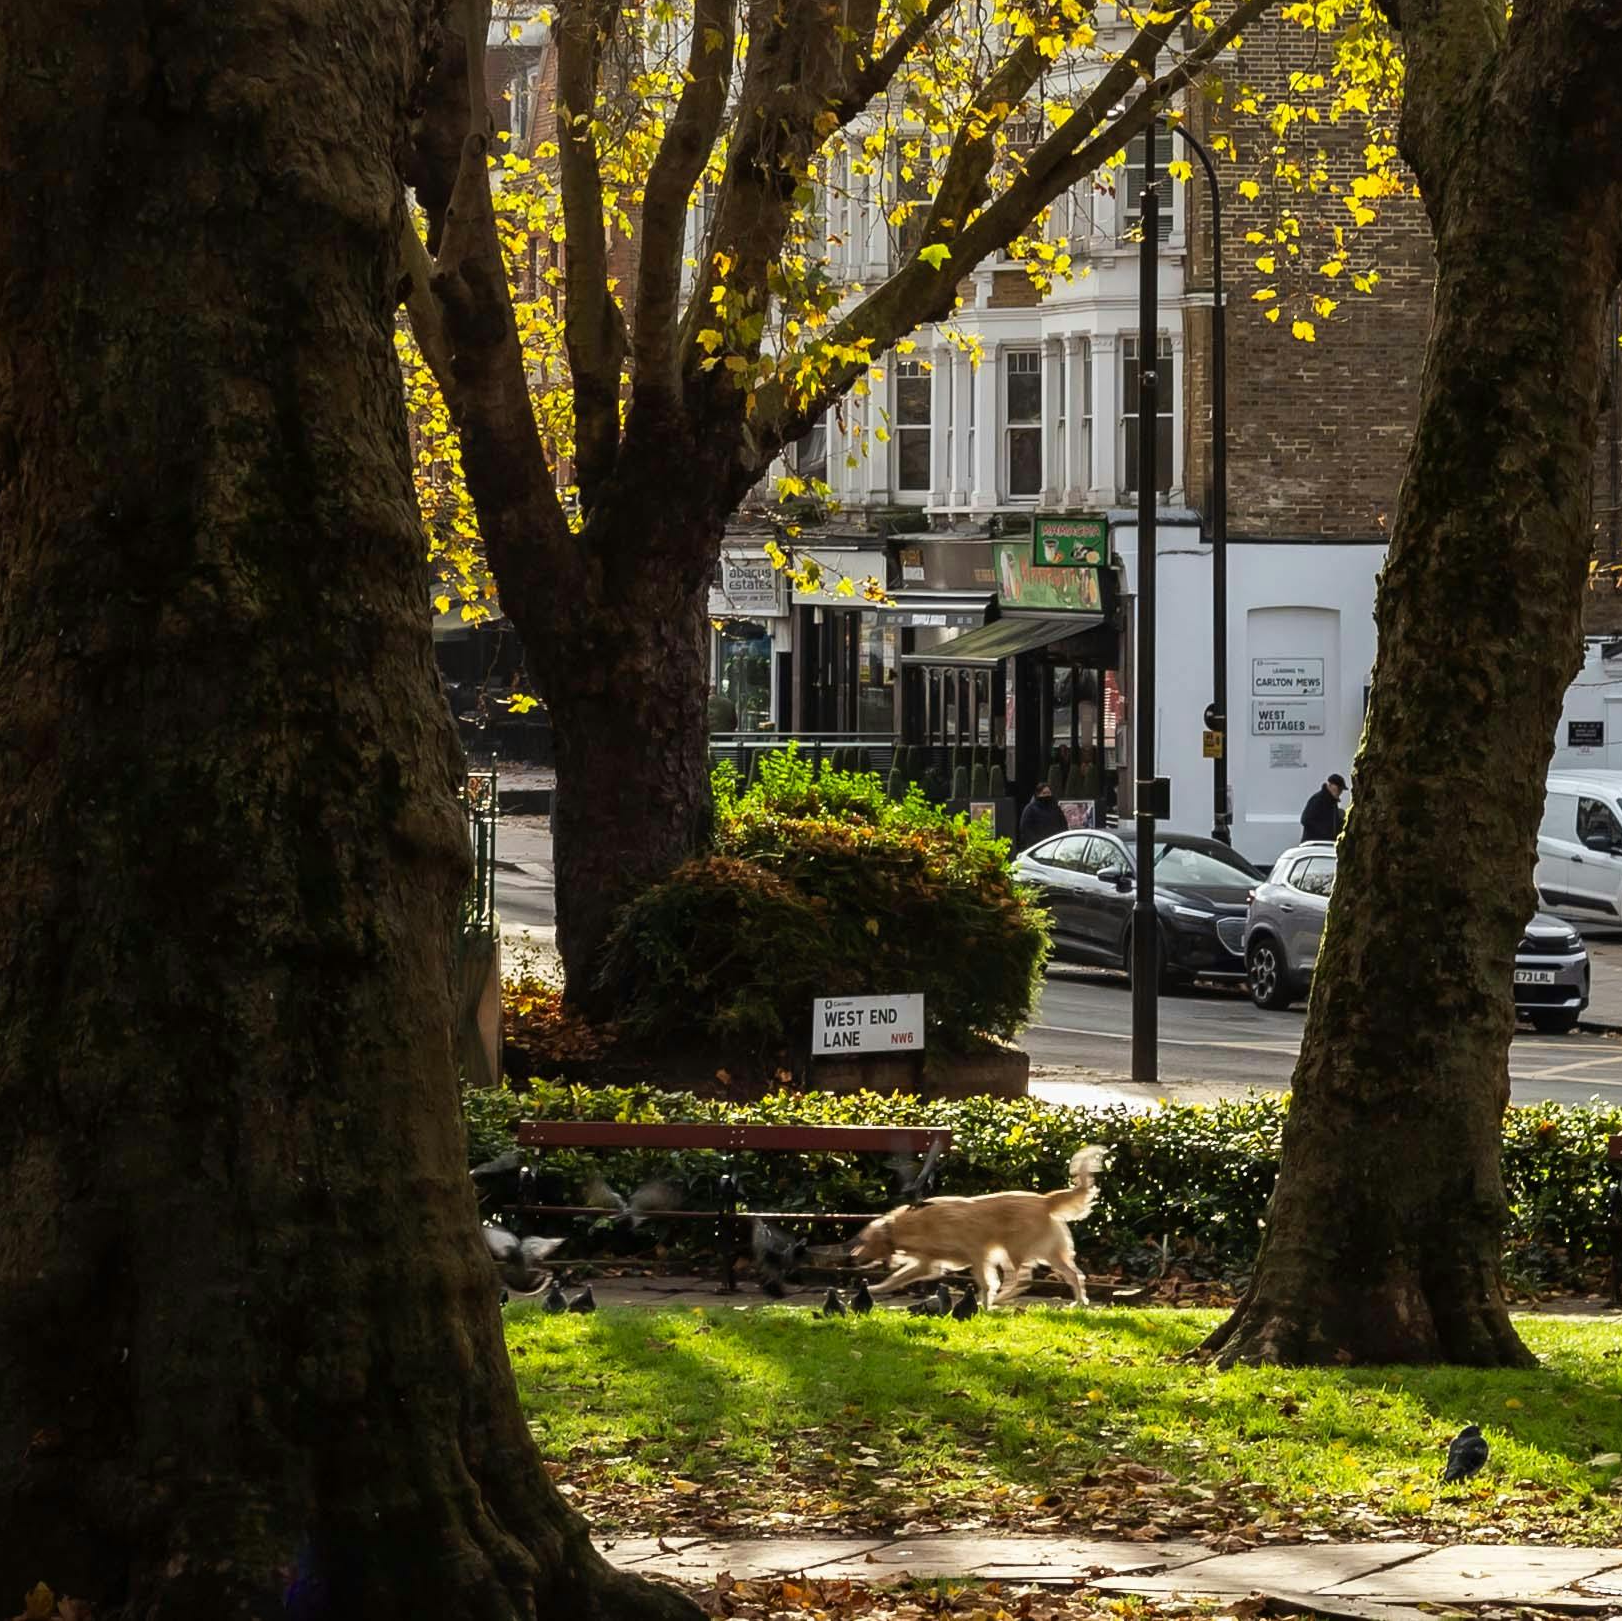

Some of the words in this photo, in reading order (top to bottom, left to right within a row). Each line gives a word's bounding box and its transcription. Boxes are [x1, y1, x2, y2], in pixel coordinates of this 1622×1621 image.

[729, 567, 772, 579] abacus
[729, 579, 772, 590] estates
[1256, 678, 1293, 687] CARLTON
[1296, 678, 1321, 687] MEWS
[1259, 710, 1285, 720] WEST
[1258, 721, 1305, 731] COTTAGES
[825, 1010, 864, 1028] WEST
[870, 1008, 898, 1025] END
[824, 1031, 860, 1047] LANE
[891, 1032, 914, 1044] NW6
